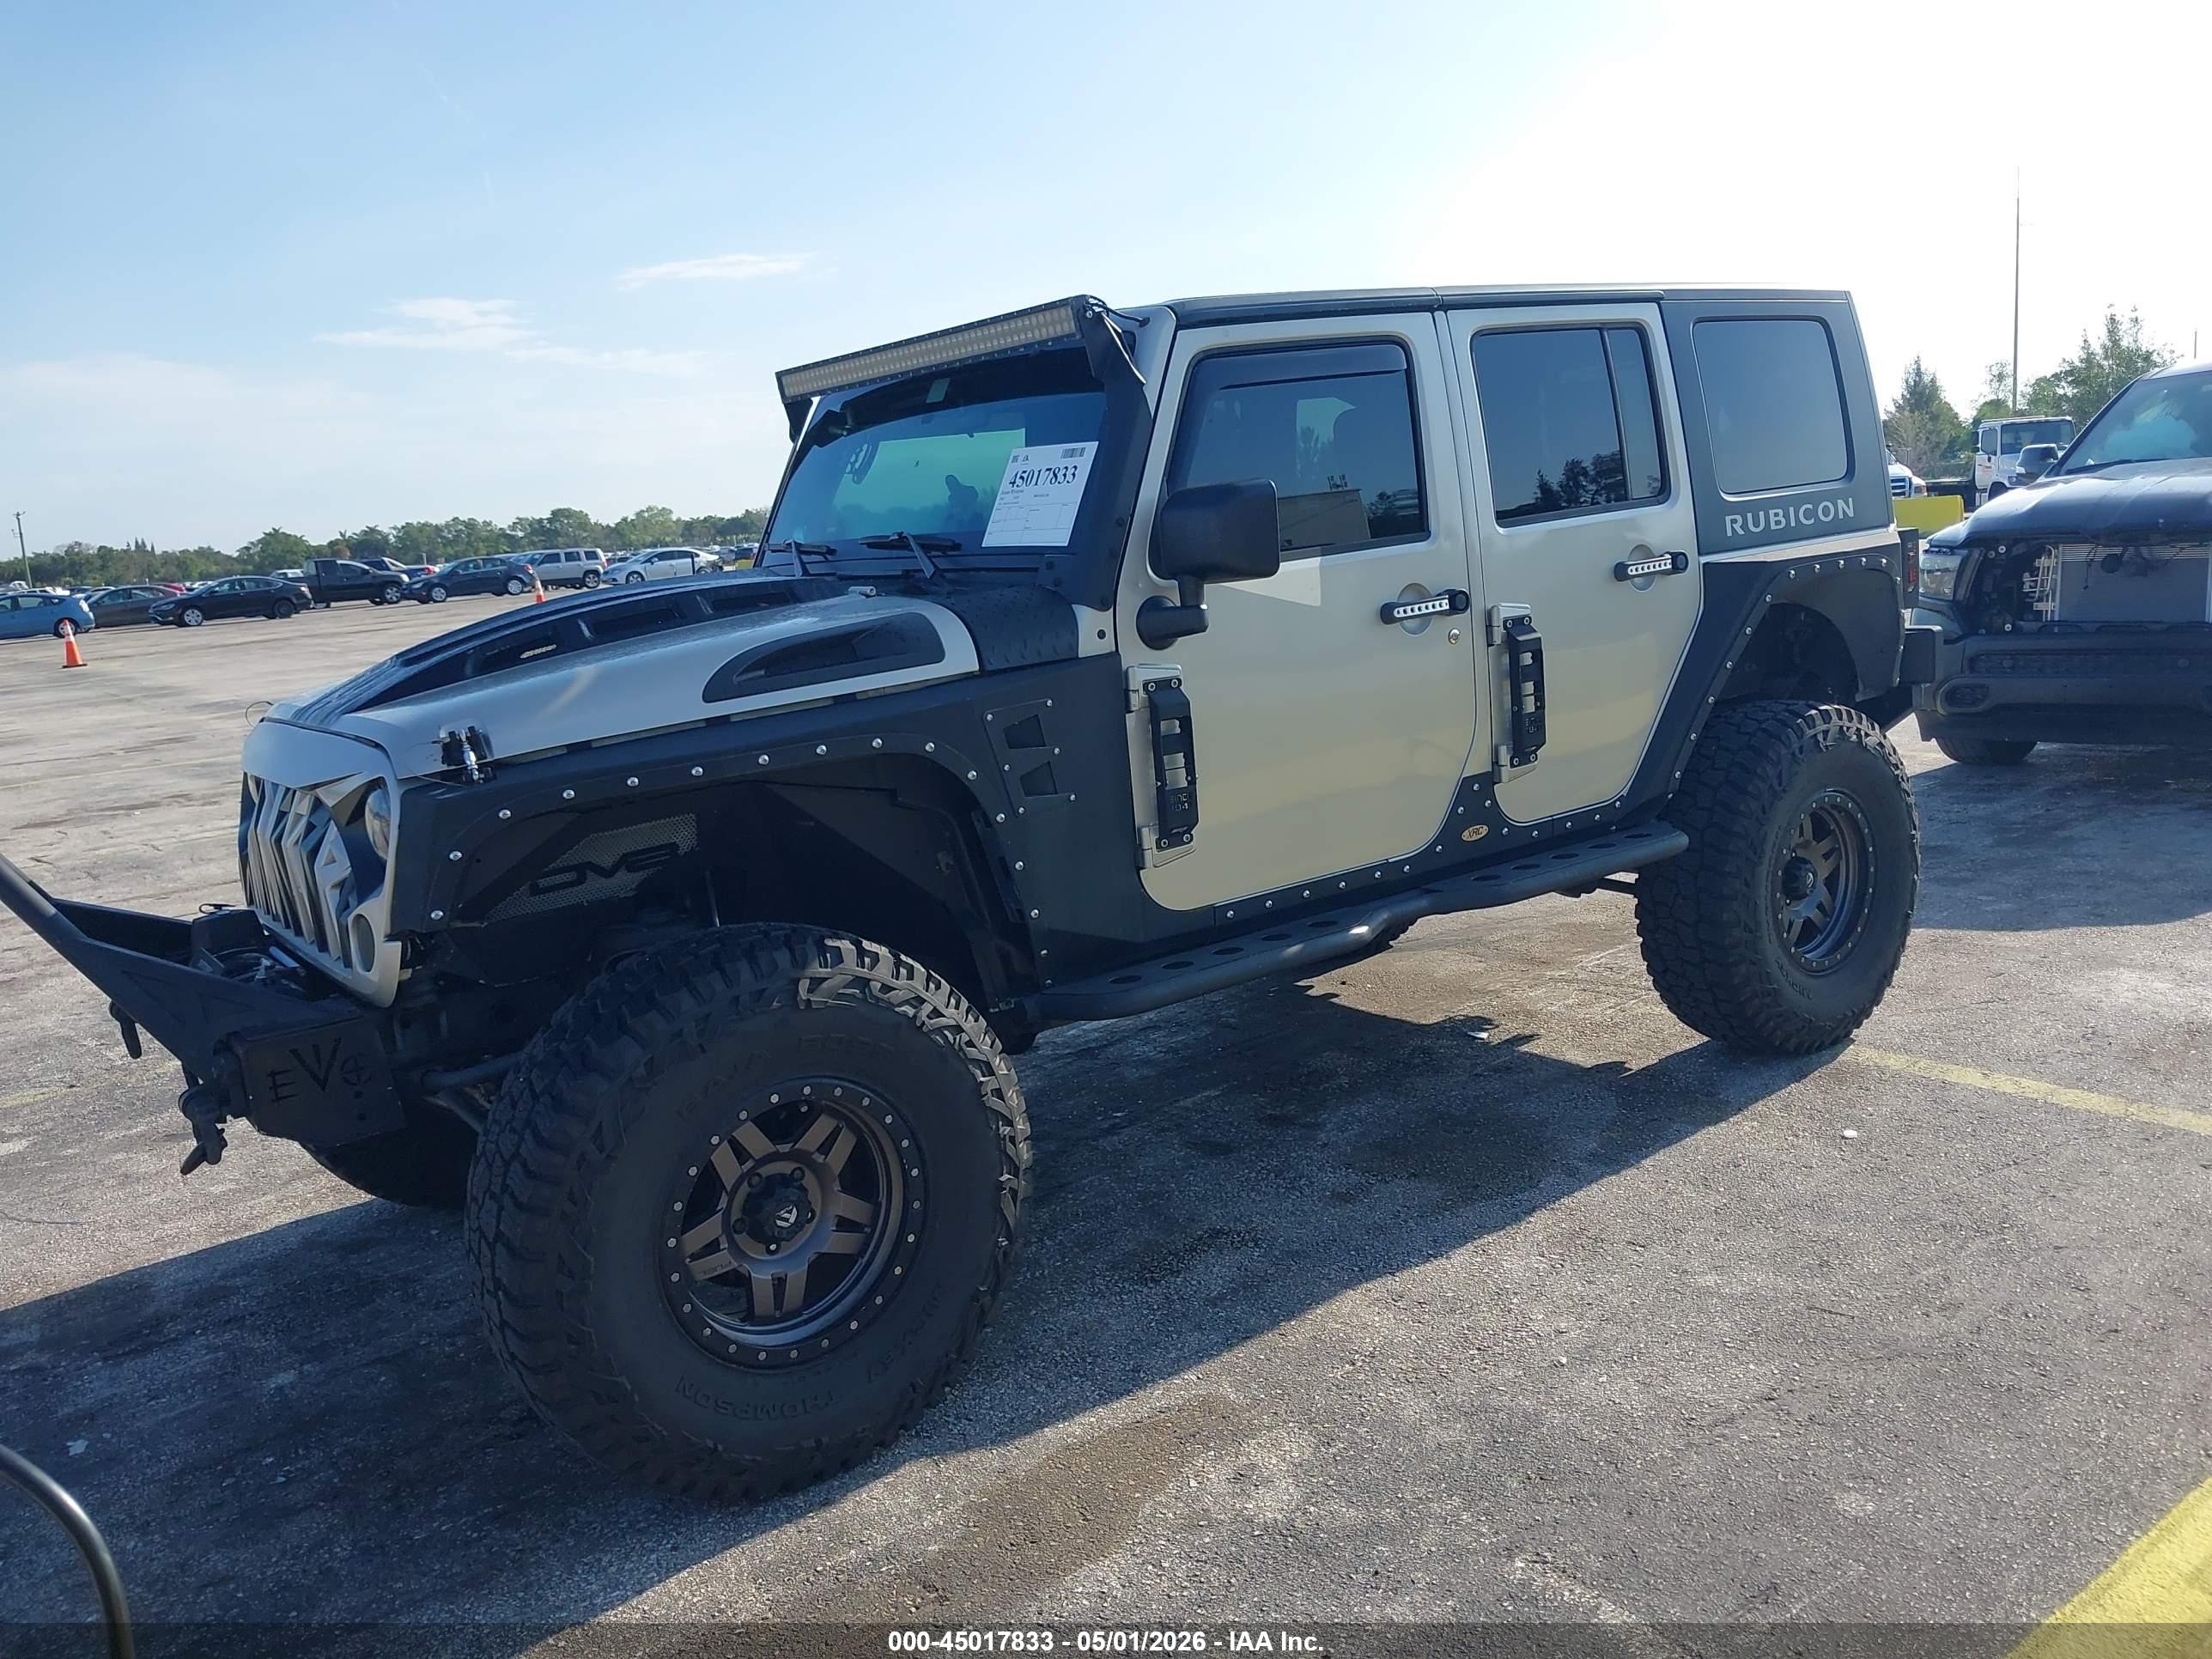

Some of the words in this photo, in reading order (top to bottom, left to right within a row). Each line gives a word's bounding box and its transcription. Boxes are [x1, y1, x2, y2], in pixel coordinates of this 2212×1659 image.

[1009, 465, 1079, 488] 45017833
[1724, 497, 1855, 537] RUBICON
[673, 1372, 842, 1421] THOMPSON
